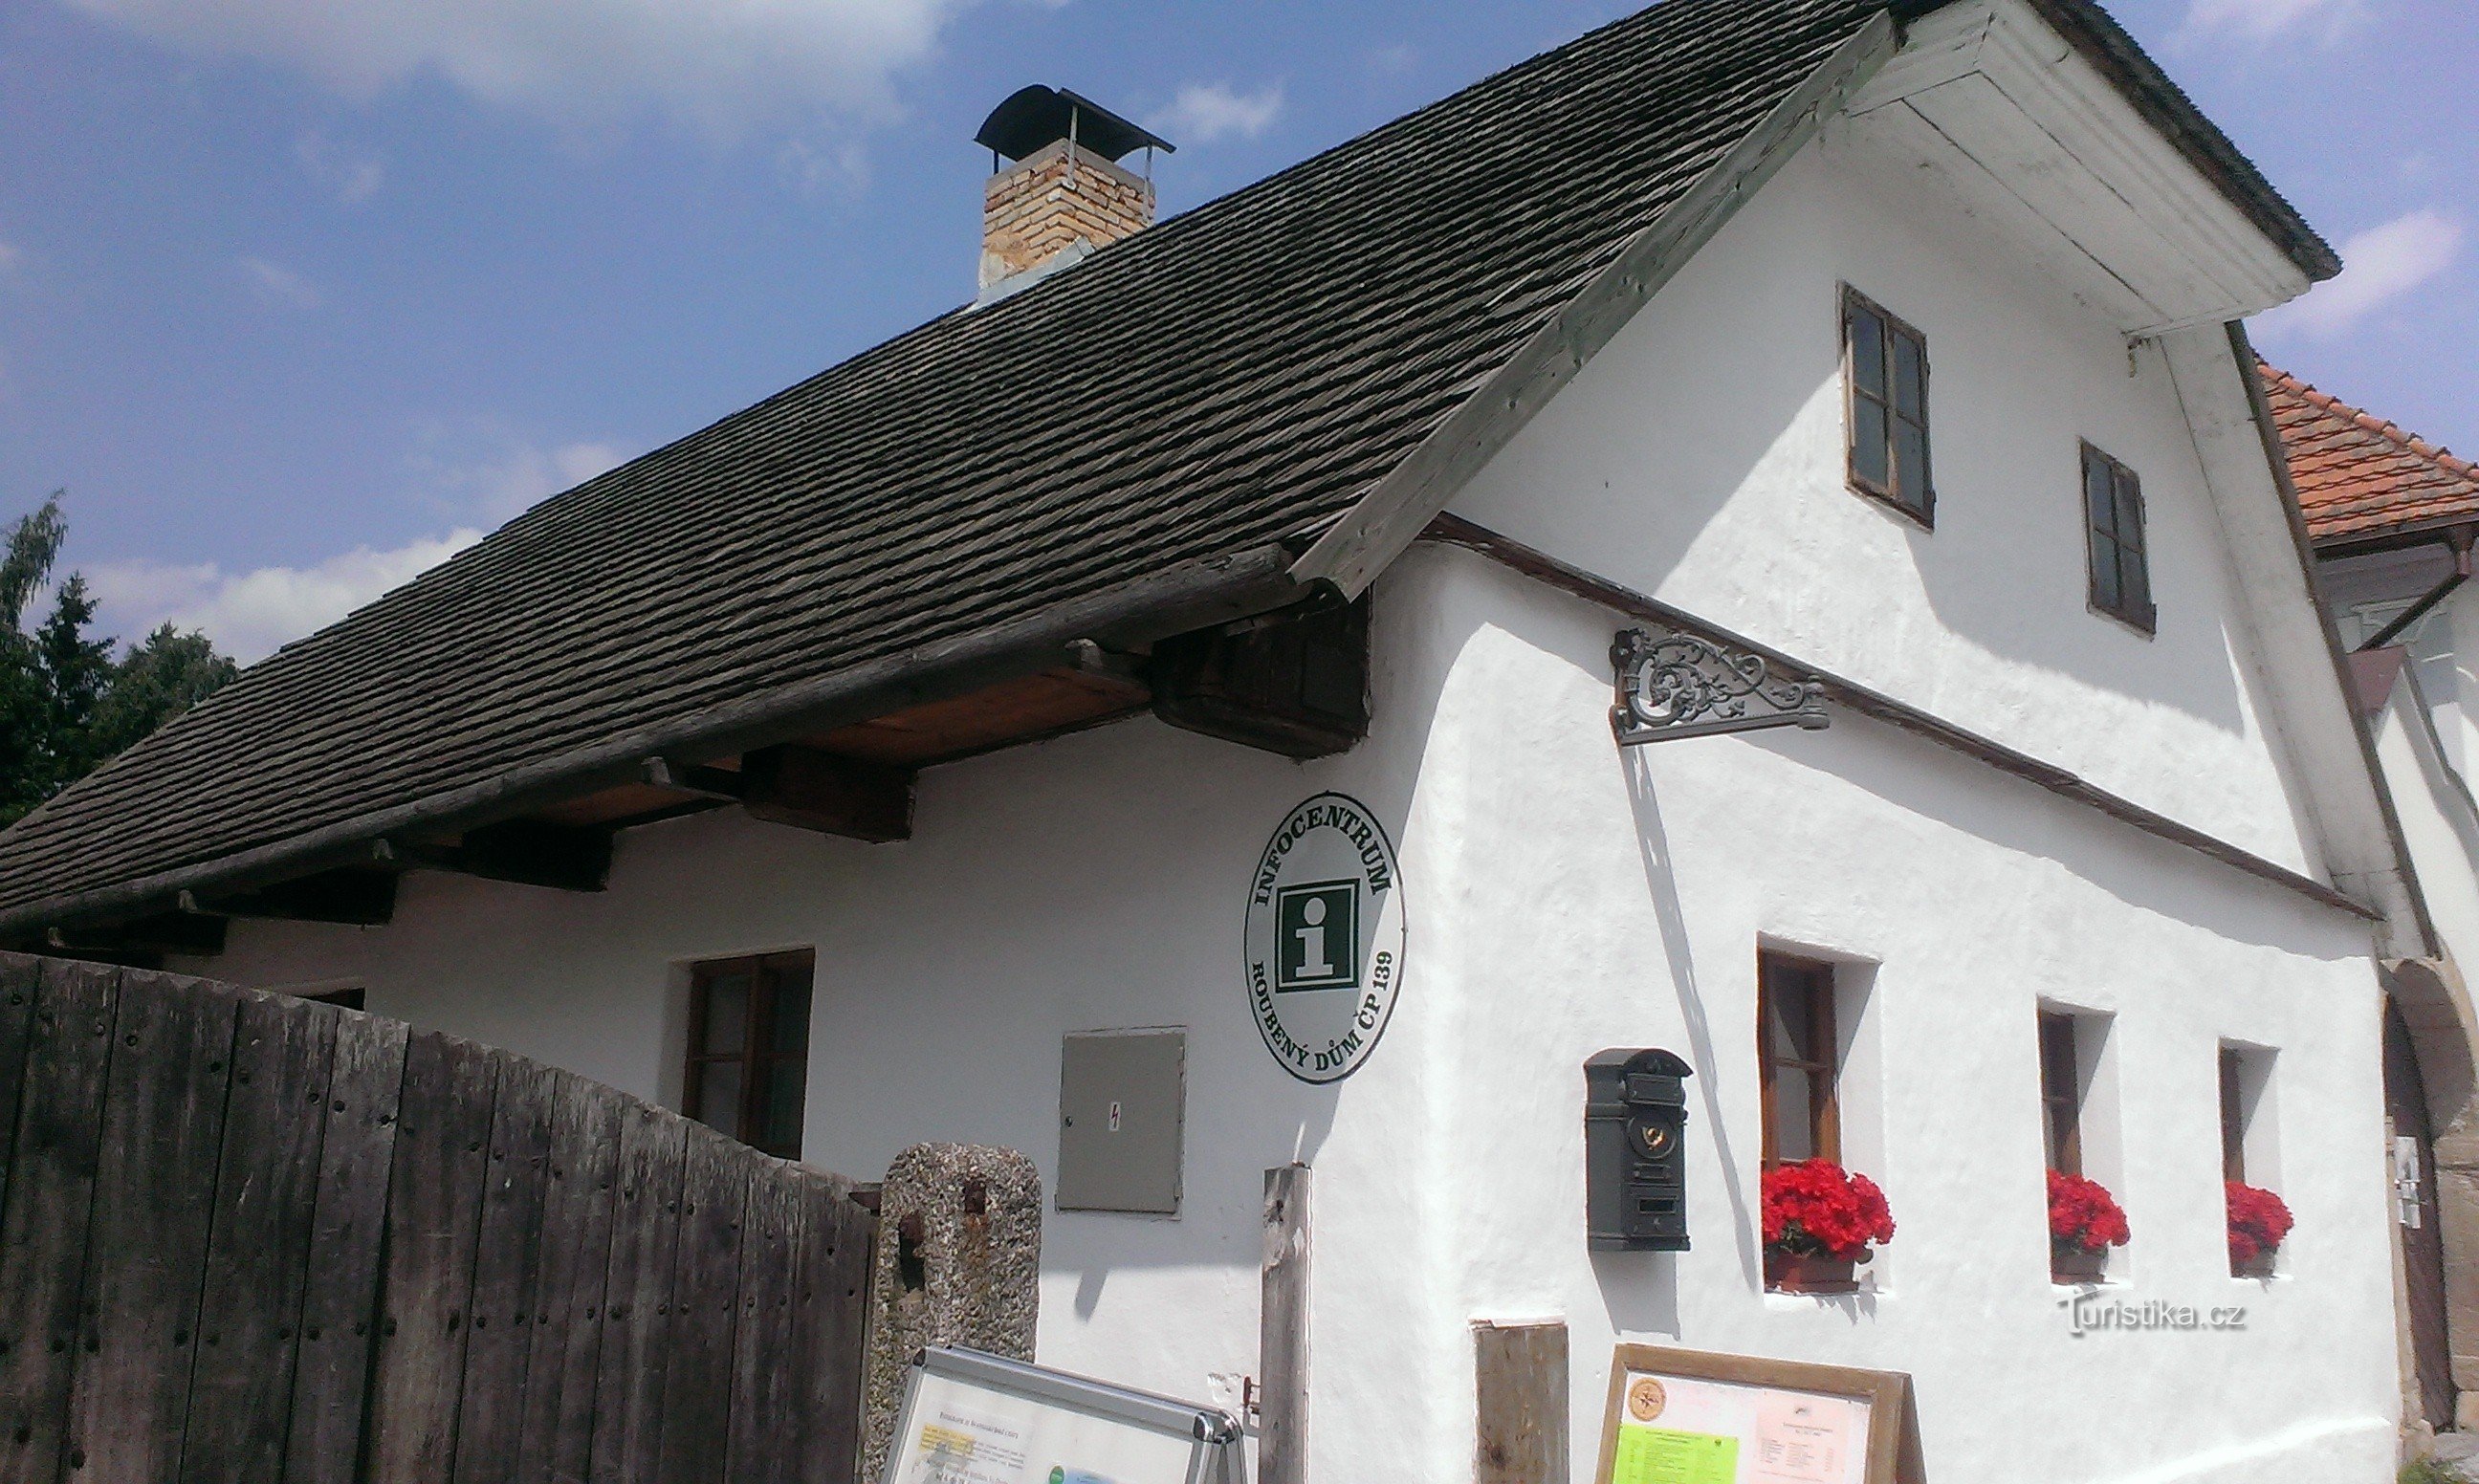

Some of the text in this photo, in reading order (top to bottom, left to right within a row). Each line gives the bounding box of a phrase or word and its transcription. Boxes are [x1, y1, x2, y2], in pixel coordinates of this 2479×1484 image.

[1254, 805, 1393, 906] INFOCENTRUM
[1251, 949, 1394, 1072] ROUBENÝ DŮM ČP 139
